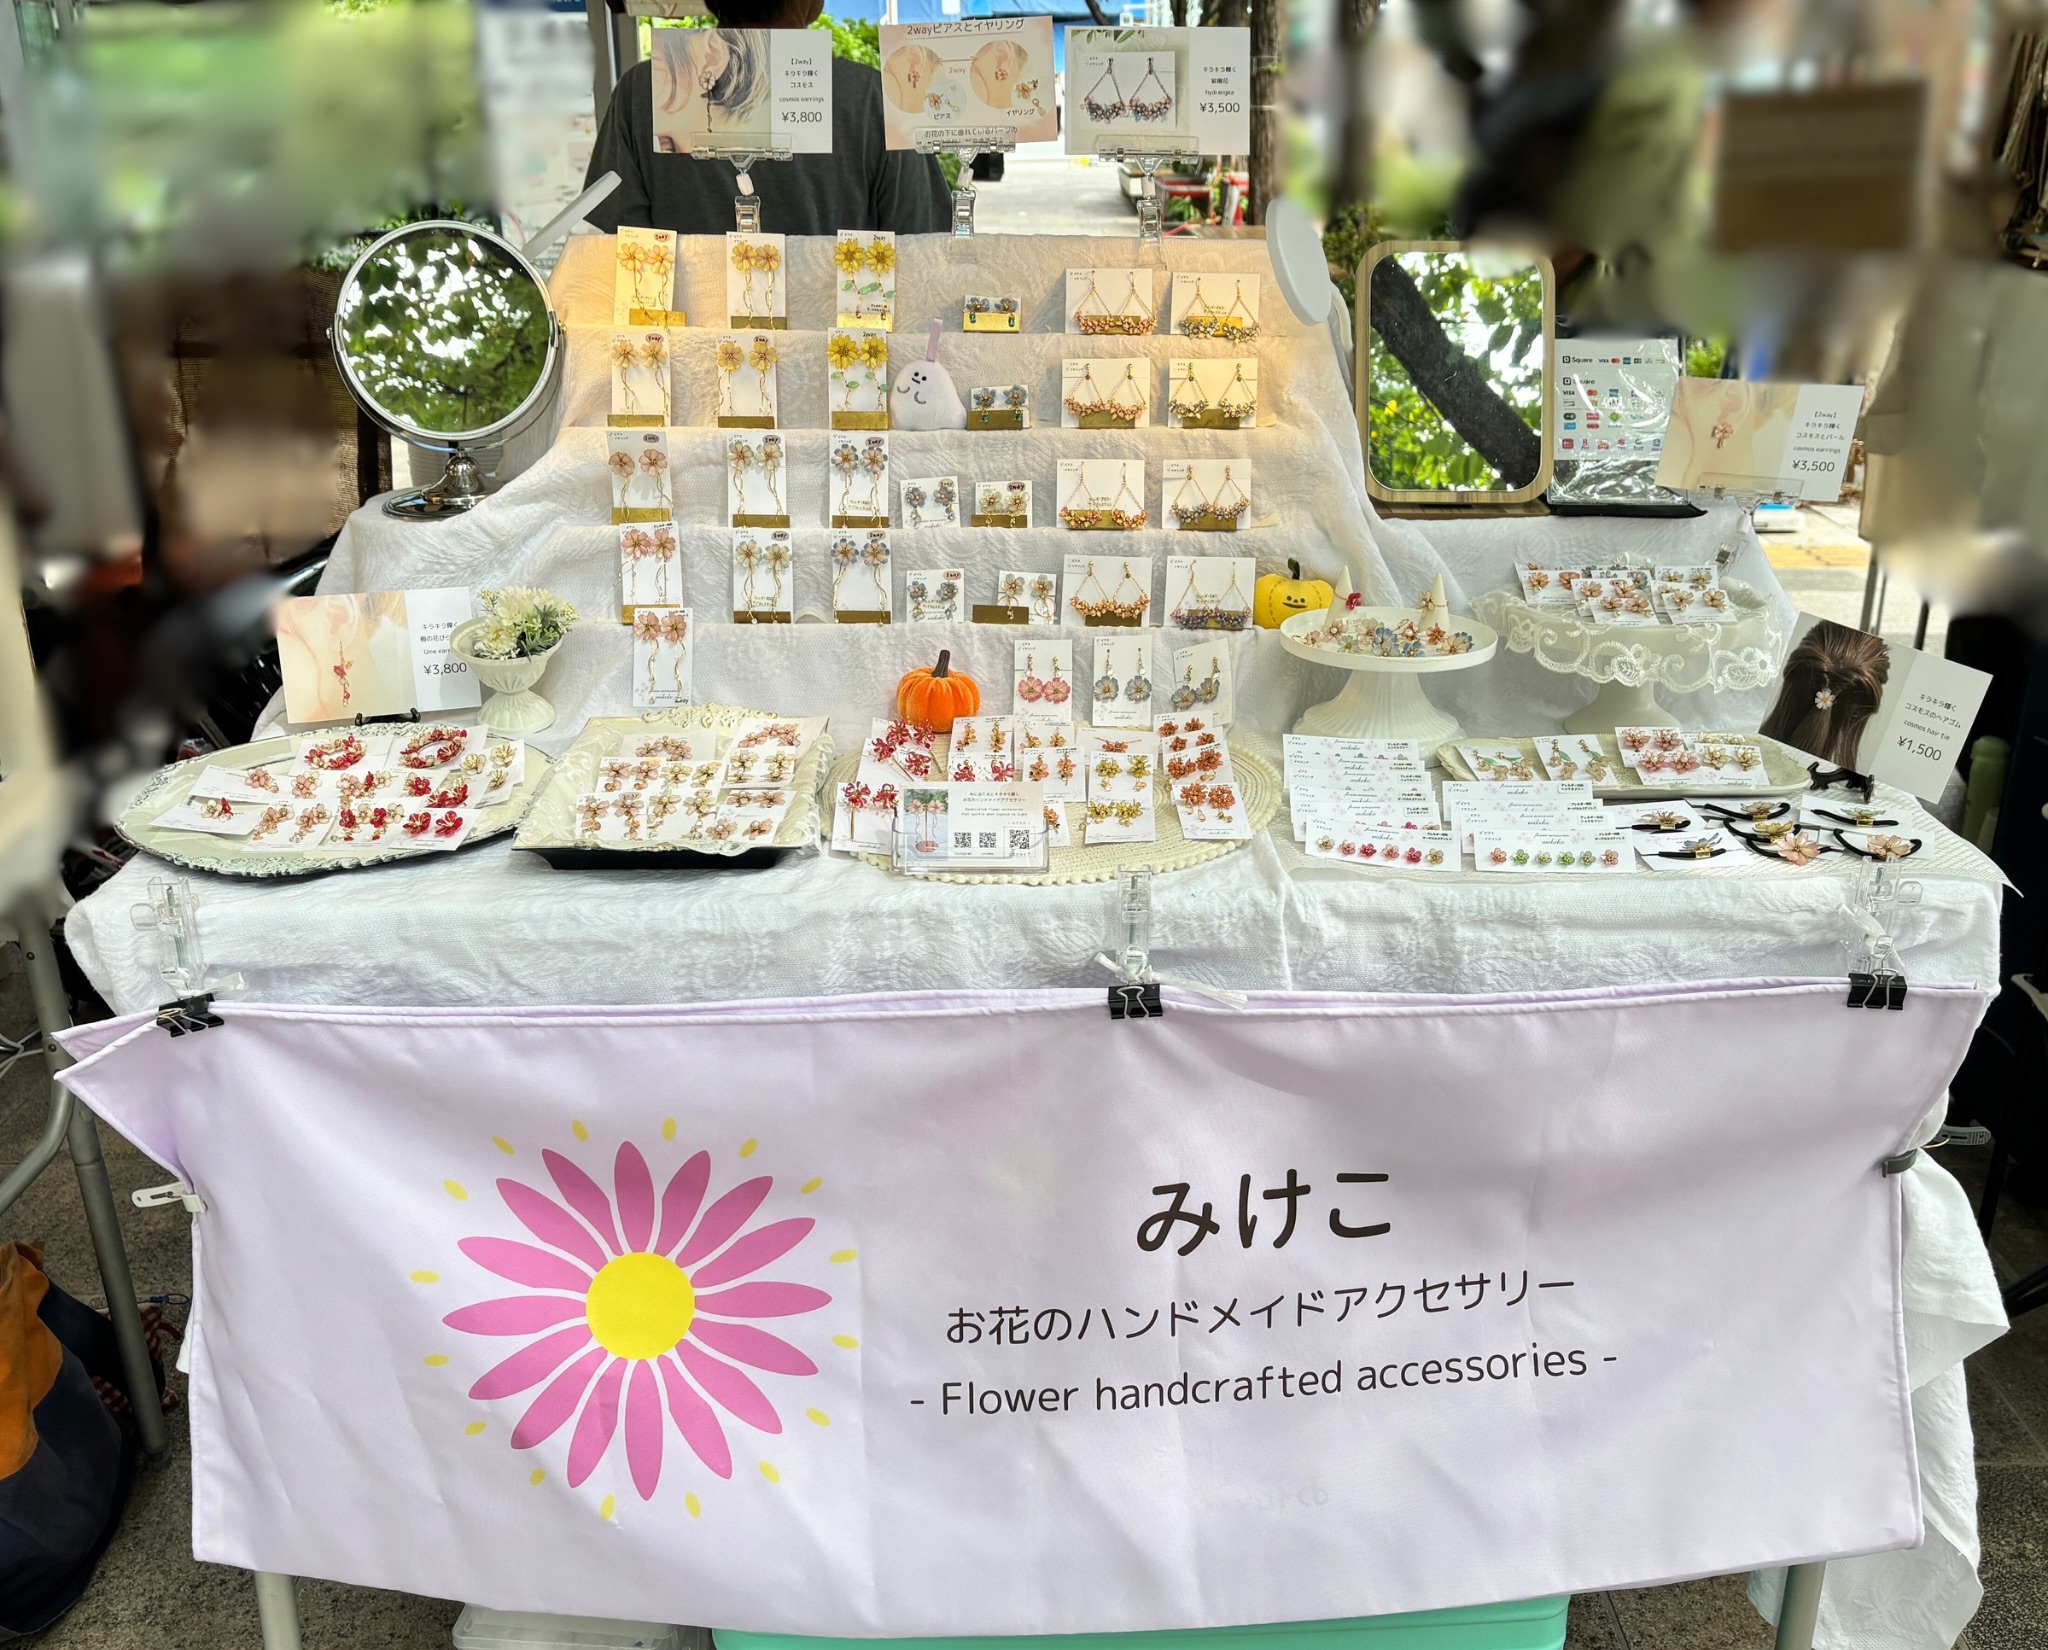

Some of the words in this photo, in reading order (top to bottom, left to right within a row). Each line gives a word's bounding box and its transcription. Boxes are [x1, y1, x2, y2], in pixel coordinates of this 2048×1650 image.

[907, 18, 1025, 36] 2wayピアスとイヤリング
[784, 69, 818, 77] キラキラ輝く
[949, 67, 965, 75] 2way
[801, 95, 824, 104] earrings
[1204, 89, 1235, 97] hydrangea
[1006, 108, 1035, 116] イヤリング
[1199, 102, 1240, 114] ¥3,500
[782, 111, 822, 124] ¥3,800
[1571, 356, 1593, 364] Square
[1805, 421, 1840, 430] キラキラ輝く
[1792, 459, 1835, 472] ¥3,500
[422, 621, 458, 630] キラキラ輝く
[423, 661, 467, 675] ¥3,800
[1919, 693, 1957, 712] キラキラ輝く
[1904, 702, 1961, 729] コスモスのヘアゴム
[1903, 719, 1926, 732] cosmos
[1926, 727, 1939, 737] hair
[1940, 732, 1951, 741] tie
[1897, 735, 1942, 761] ¥1,500
[1137, 1169, 1390, 1256] みけこ
[947, 1270, 1575, 1345] お花のハンドメイドアクセサリー
[943, 1381, 1079, 1416] Flower
[1096, 1360, 1342, 1411] handcrafted
[1358, 1343, 1587, 1391] accessories
